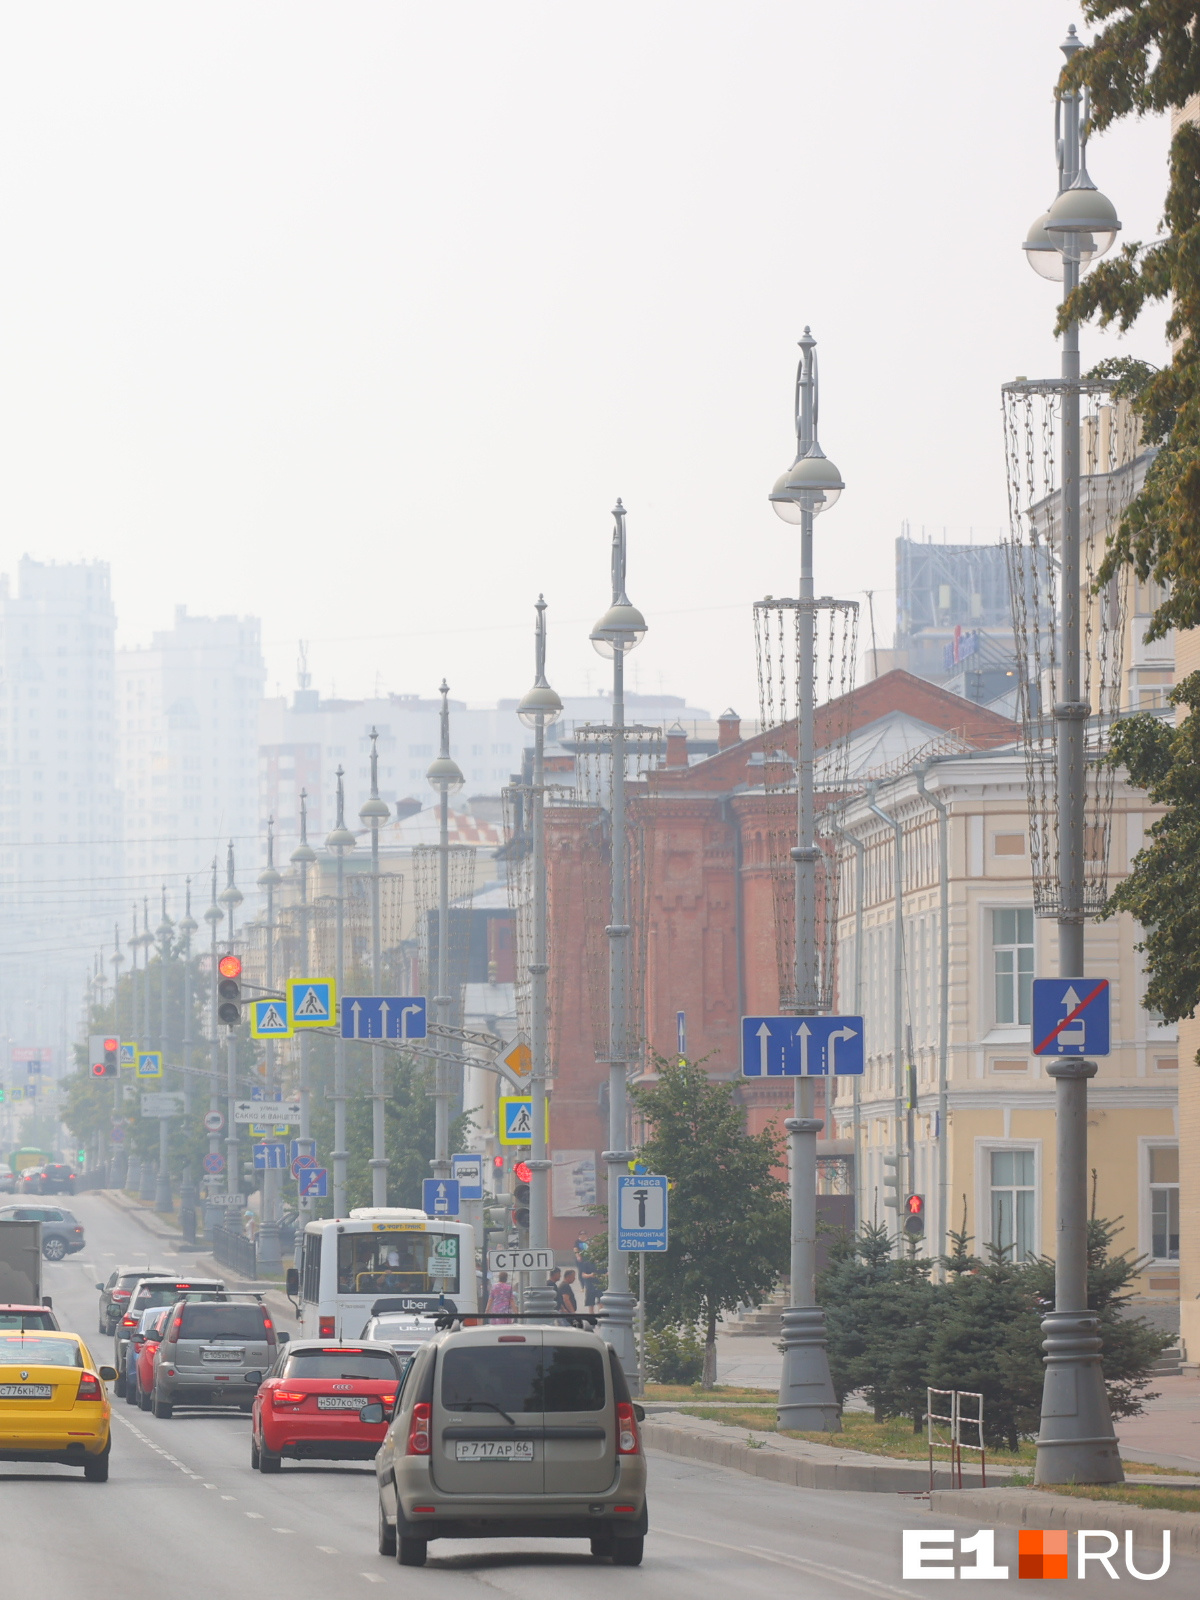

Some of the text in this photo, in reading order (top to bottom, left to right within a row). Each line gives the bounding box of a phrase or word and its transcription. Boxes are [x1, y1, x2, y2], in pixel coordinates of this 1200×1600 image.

[260, 1104, 279, 1112] улица
[235, 1112, 259, 1120] САККО
[260, 1112, 266, 1120] И
[623, 1177, 661, 1187] 24 часа
[213, 1195, 242, 1204] СТОП
[437, 1239, 456, 1256] 48
[495, 1252, 548, 1268] СТОП
[401, 1299, 428, 1310] Uber
[0, 1385, 49, 1395] С776КН 797
[320, 1397, 366, 1407] Н507КО 196
[515, 1441, 529, 1452] 66
